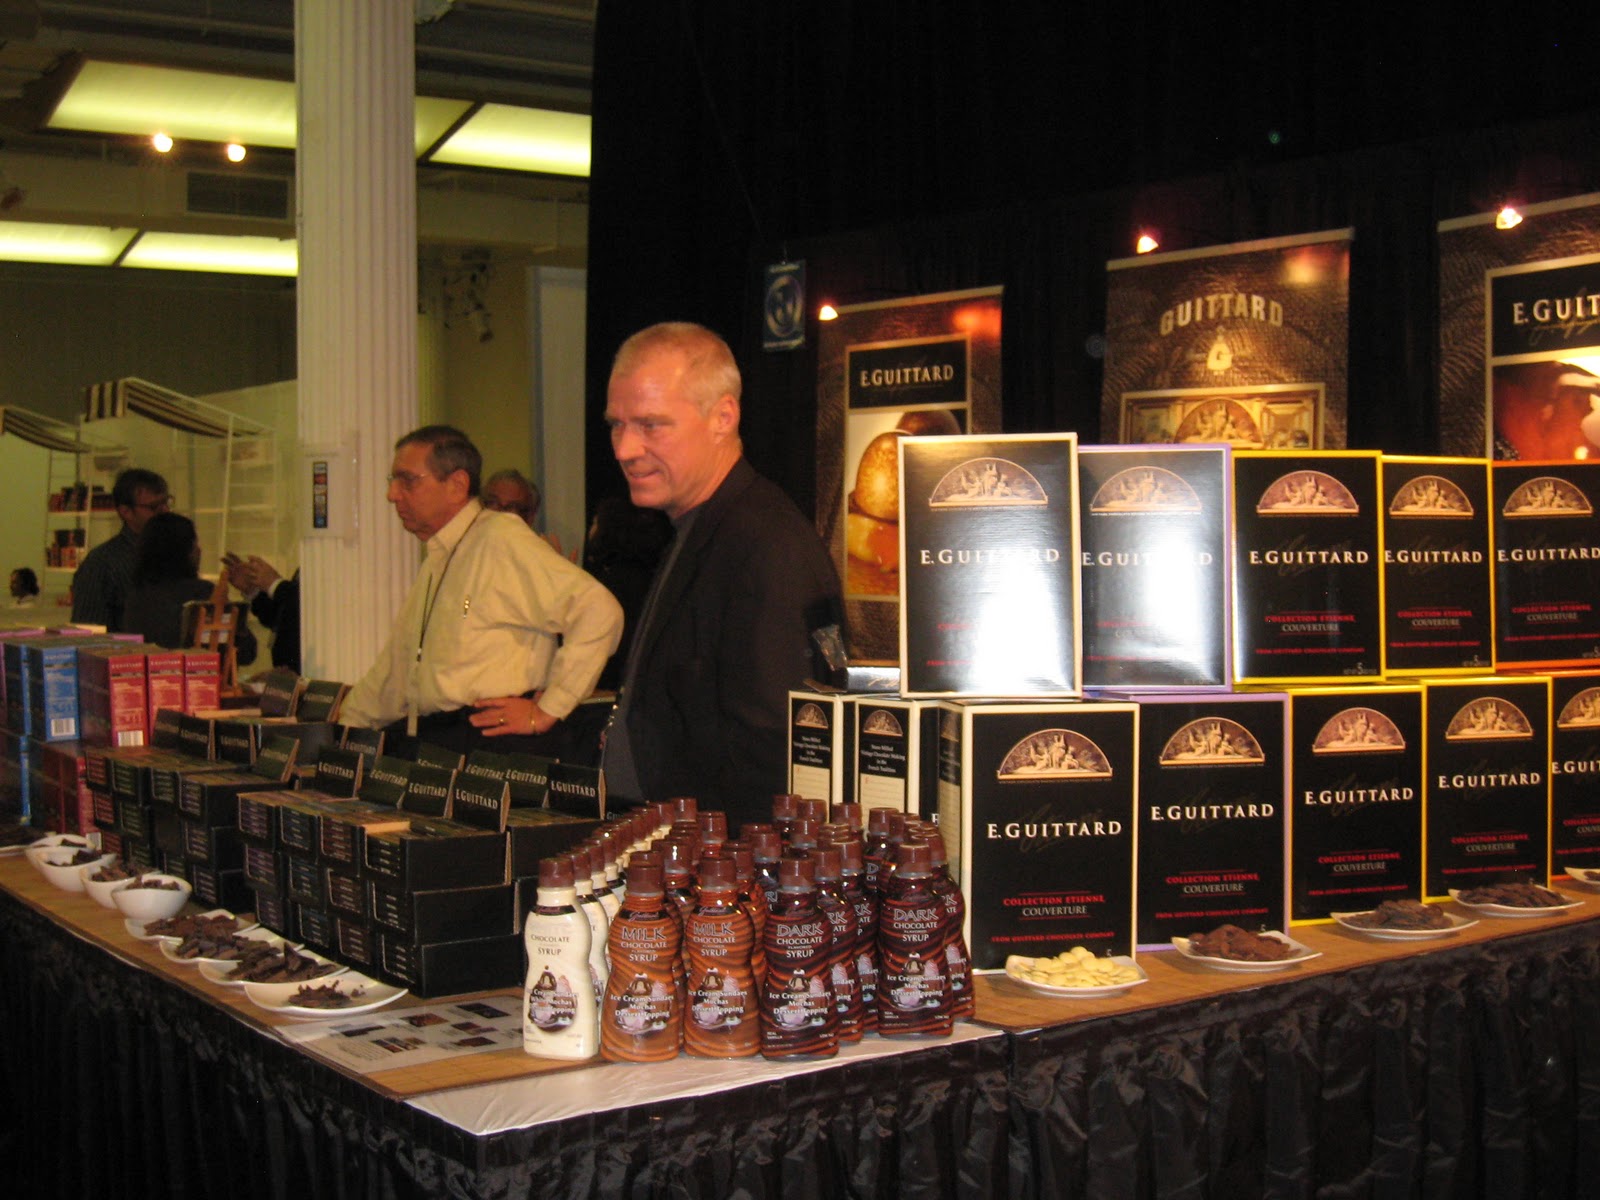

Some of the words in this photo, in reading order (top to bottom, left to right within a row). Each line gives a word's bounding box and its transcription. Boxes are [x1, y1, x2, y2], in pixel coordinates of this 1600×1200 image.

[1159, 292, 1283, 336] GUITTARD
[987, 821, 1122, 839] E.GUITTARD
[1183, 883, 1244, 894] COUVERTURE
[1003, 897, 1062, 906] COLLECTION
[1065, 895, 1104, 904] ETIENNE
[893, 908, 939, 921] DARK
[1022, 905, 1088, 916] COUVERTURE
[693, 922, 735, 937] MILK
[777, 922, 824, 937] DARK
[893, 921, 937, 929] CHOCOLATE
[531, 934, 570, 943] CHOCOLATE
[621, 926, 666, 941] MILK
[903, 934, 929, 942] SYRUP
[621, 941, 667, 949] CHOCOLATE
[777, 937, 822, 945] CHOCOLATE
[538, 947, 562, 956] SYRUP
[701, 949, 728, 957] SYRUP
[786, 949, 814, 958] SYRUP
[629, 954, 658, 962] SYRUP
